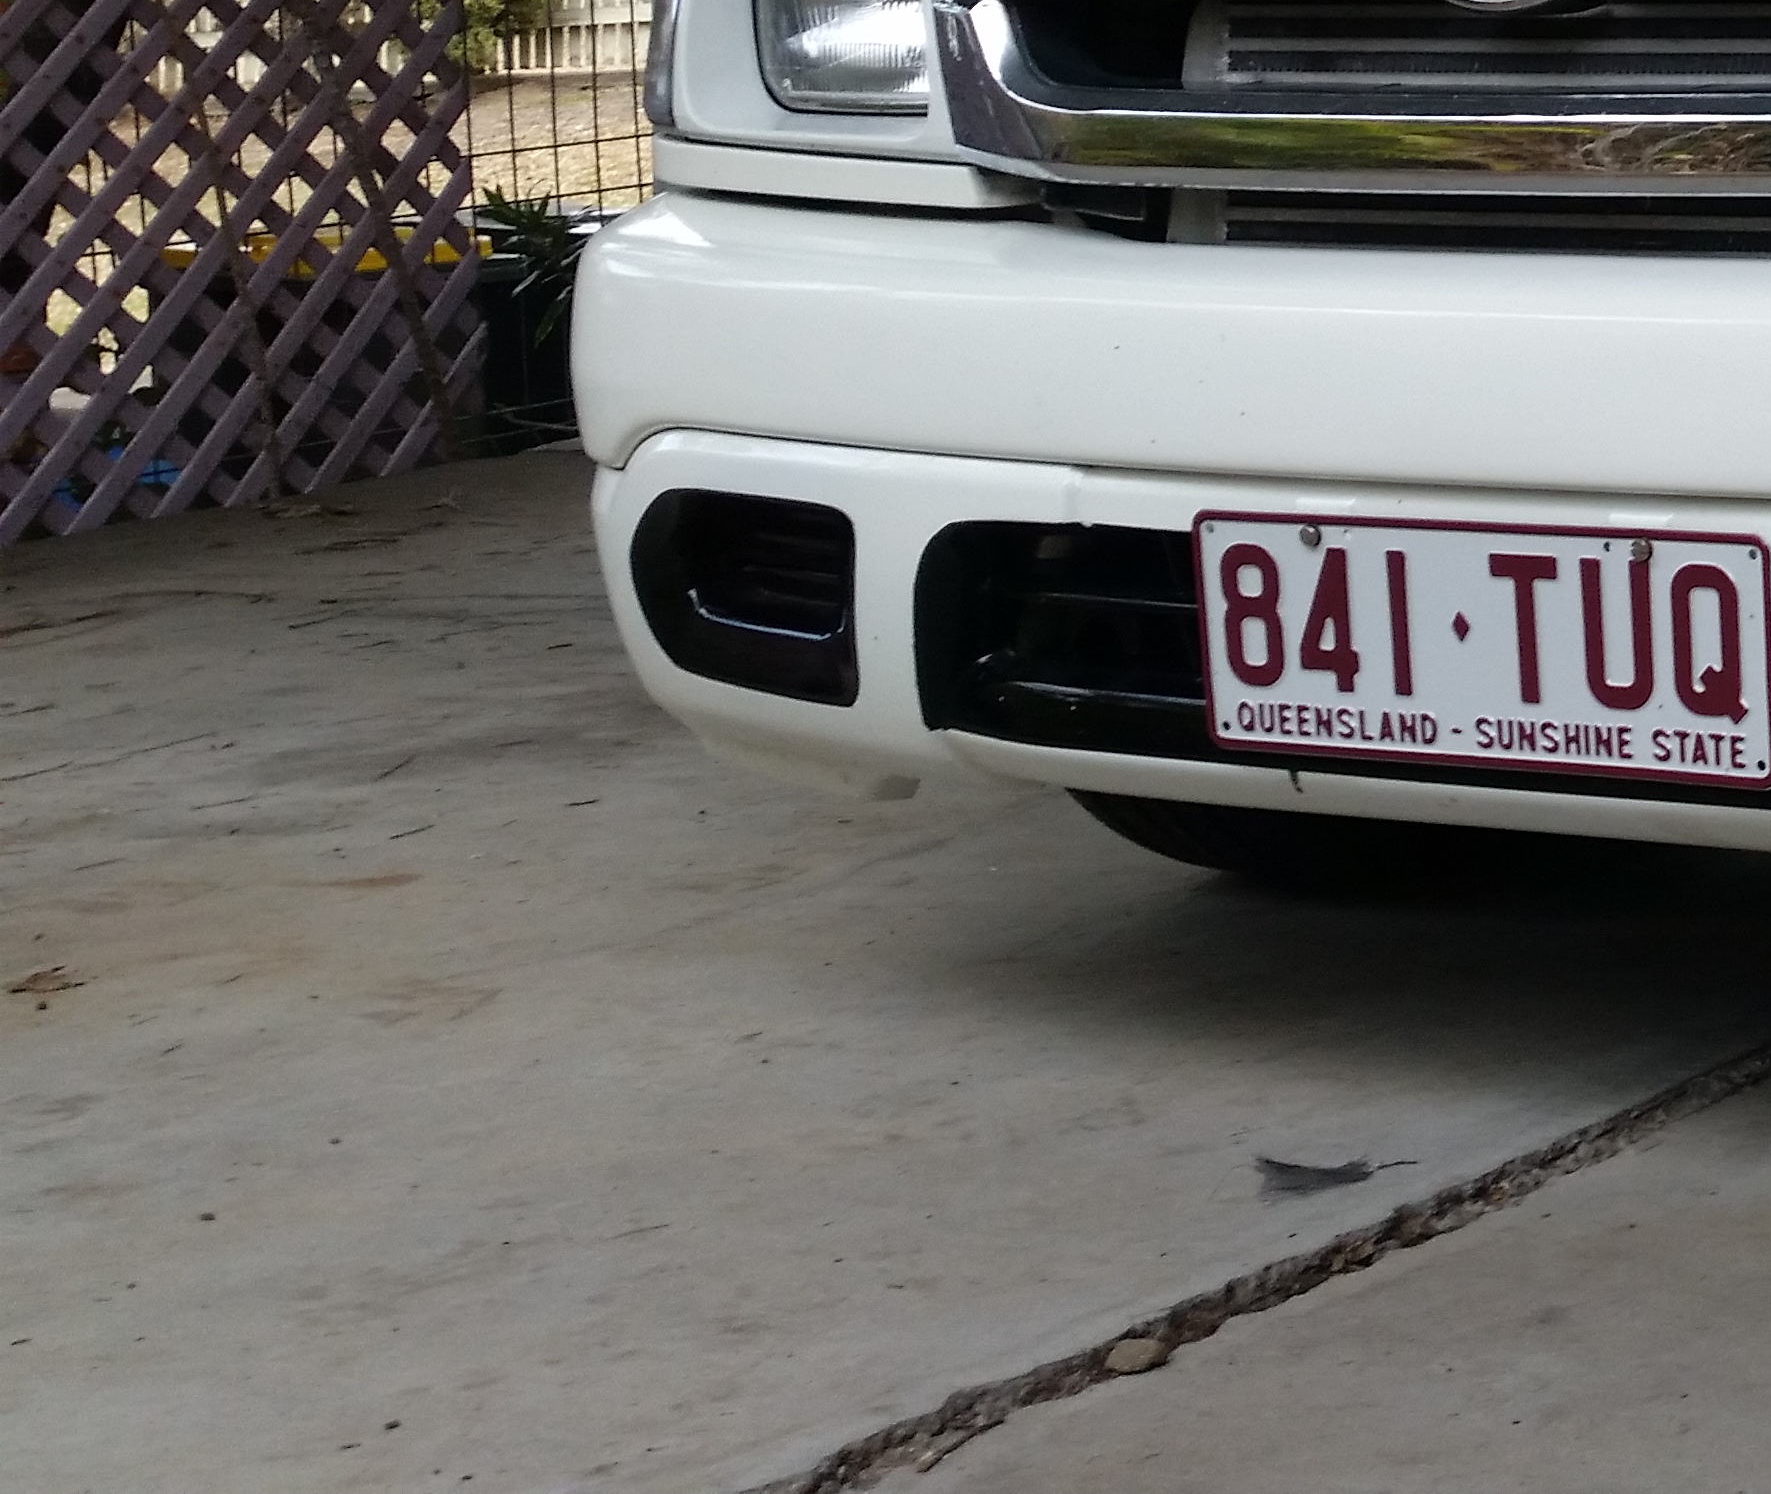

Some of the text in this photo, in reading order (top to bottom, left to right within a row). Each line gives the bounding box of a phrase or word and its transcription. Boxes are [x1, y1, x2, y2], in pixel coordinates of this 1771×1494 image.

[1219, 542, 1749, 724] 841 TUQ
[1237, 700, 1438, 746] QUEENSLAND
[1475, 716, 1635, 760] SUNSHINE
[1652, 728, 1747, 770] STATE
